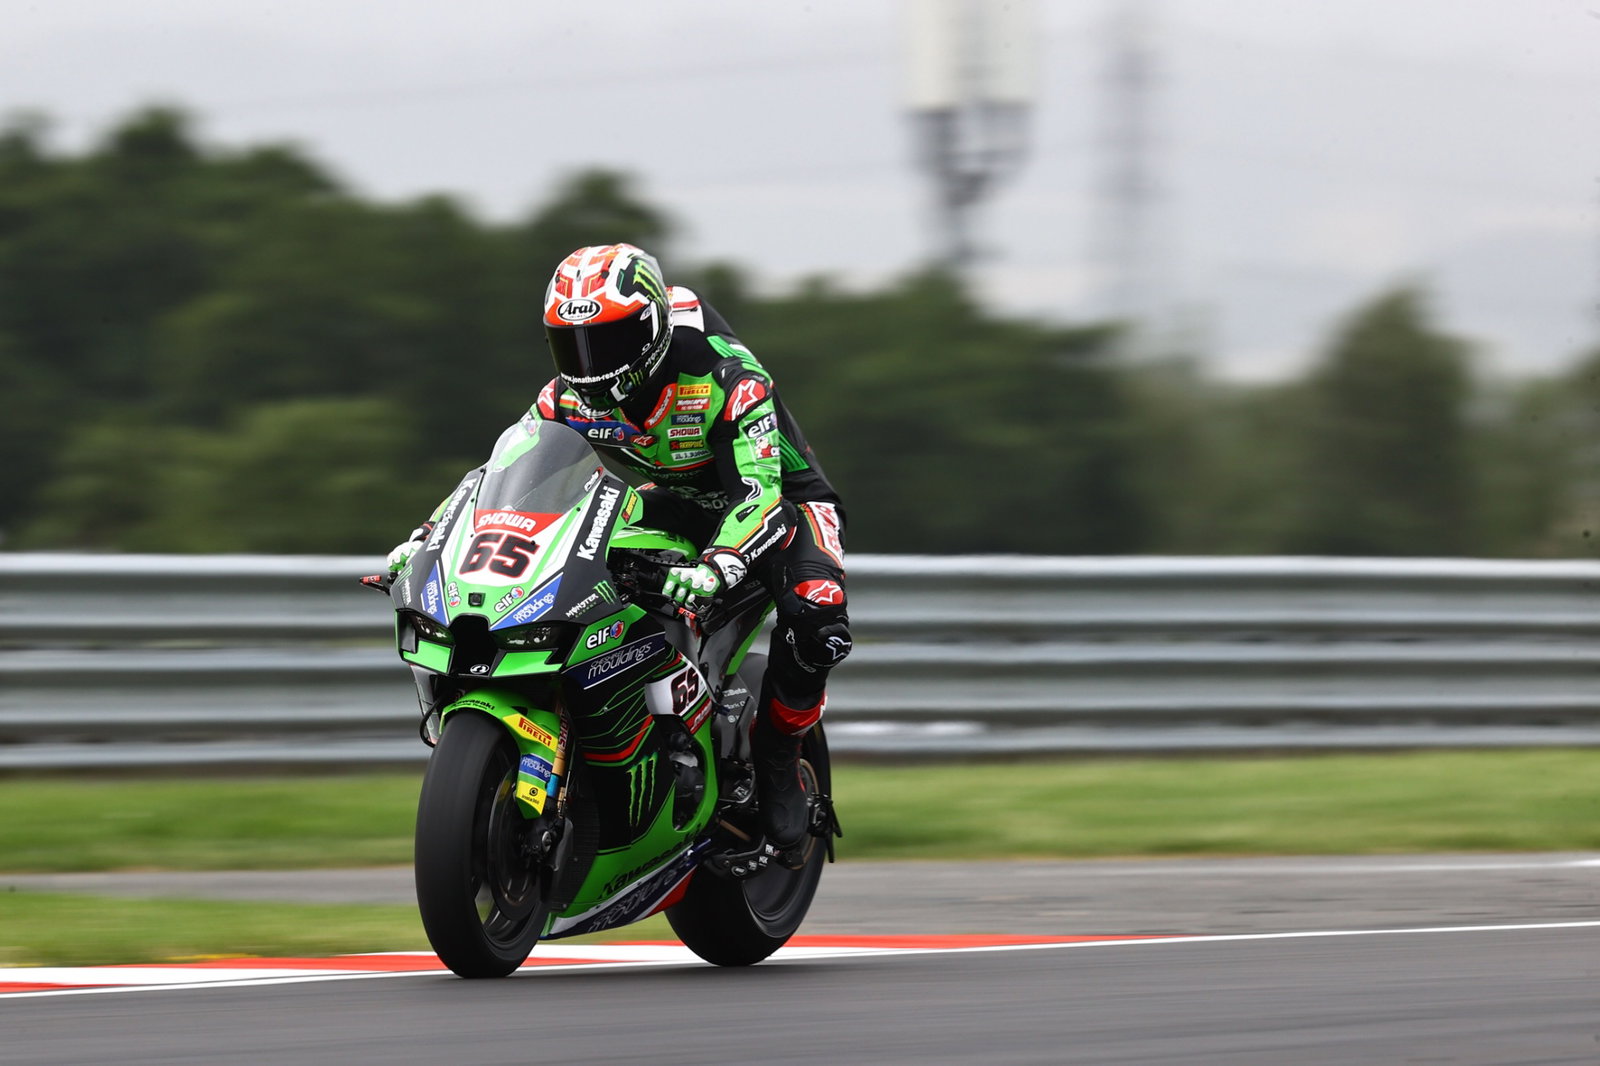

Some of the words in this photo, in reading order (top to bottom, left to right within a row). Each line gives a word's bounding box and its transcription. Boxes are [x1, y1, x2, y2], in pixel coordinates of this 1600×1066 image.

[562, 302, 594, 315] Arai
[560, 363, 630, 384] www.jonathan-rea.com
[680, 385, 709, 396] PIRELLI
[587, 428, 612, 439] elf
[670, 428, 700, 437] SHOWA
[748, 416, 772, 438] elf
[426, 478, 478, 551] Kawasaki
[476, 511, 536, 531] SHOWA
[576, 485, 621, 561] Kawasaki
[751, 523, 787, 562] Kawasaki
[459, 532, 540, 579] 65
[448, 582, 459, 597] elf
[494, 593, 513, 613] elf
[516, 592, 555, 623] mouldings
[565, 593, 599, 618] MONSTER
[586, 626, 611, 649] elf
[588, 642, 653, 680] mouldings
[671, 666, 700, 714] 65
[518, 717, 553, 747] PIRELLI
